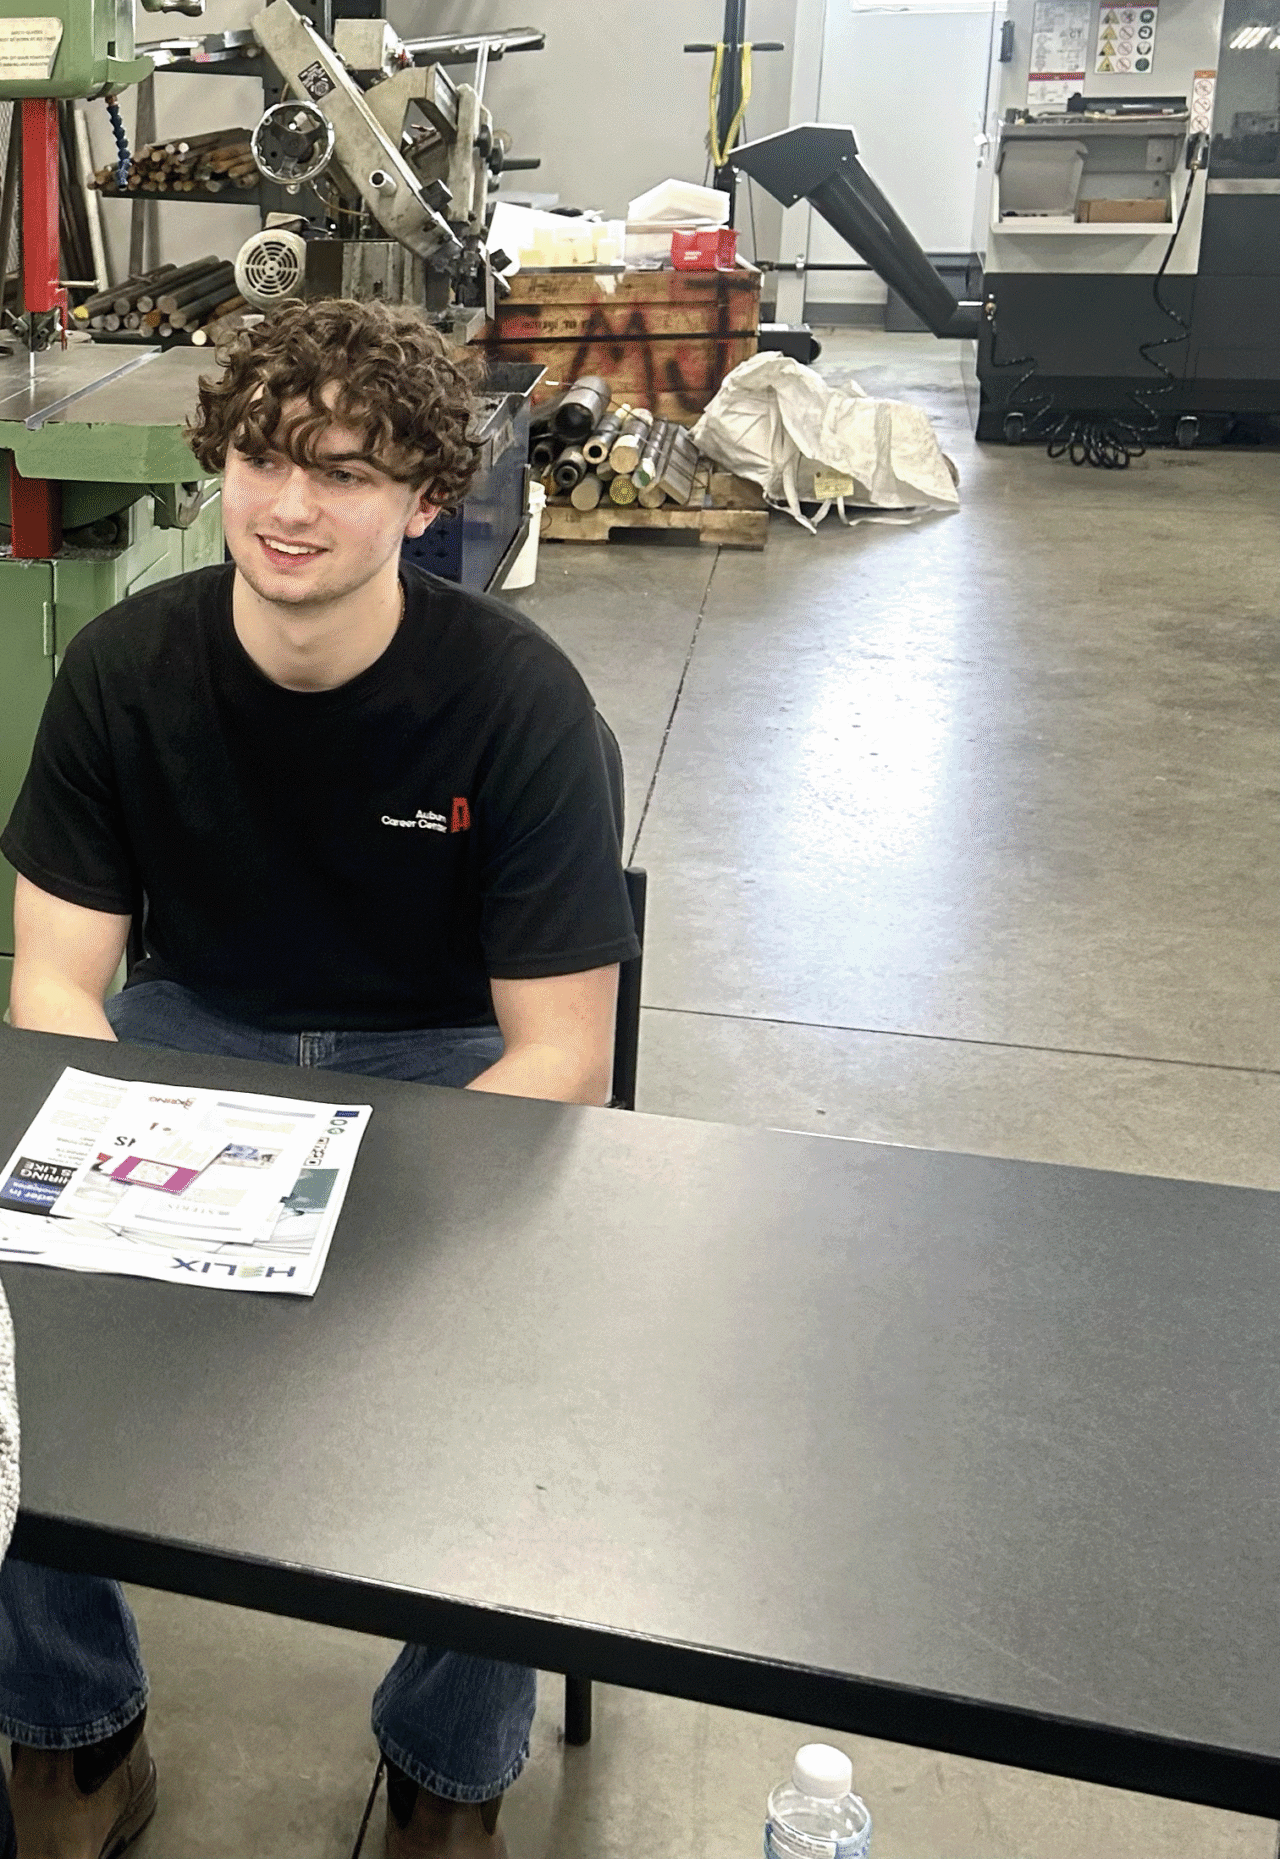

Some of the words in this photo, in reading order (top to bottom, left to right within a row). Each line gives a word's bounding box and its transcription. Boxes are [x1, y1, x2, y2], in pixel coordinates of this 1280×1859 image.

[381, 815, 417, 828] Career
[23, 1161, 58, 1175] LIKE
[9, 1187, 22, 1198] in
